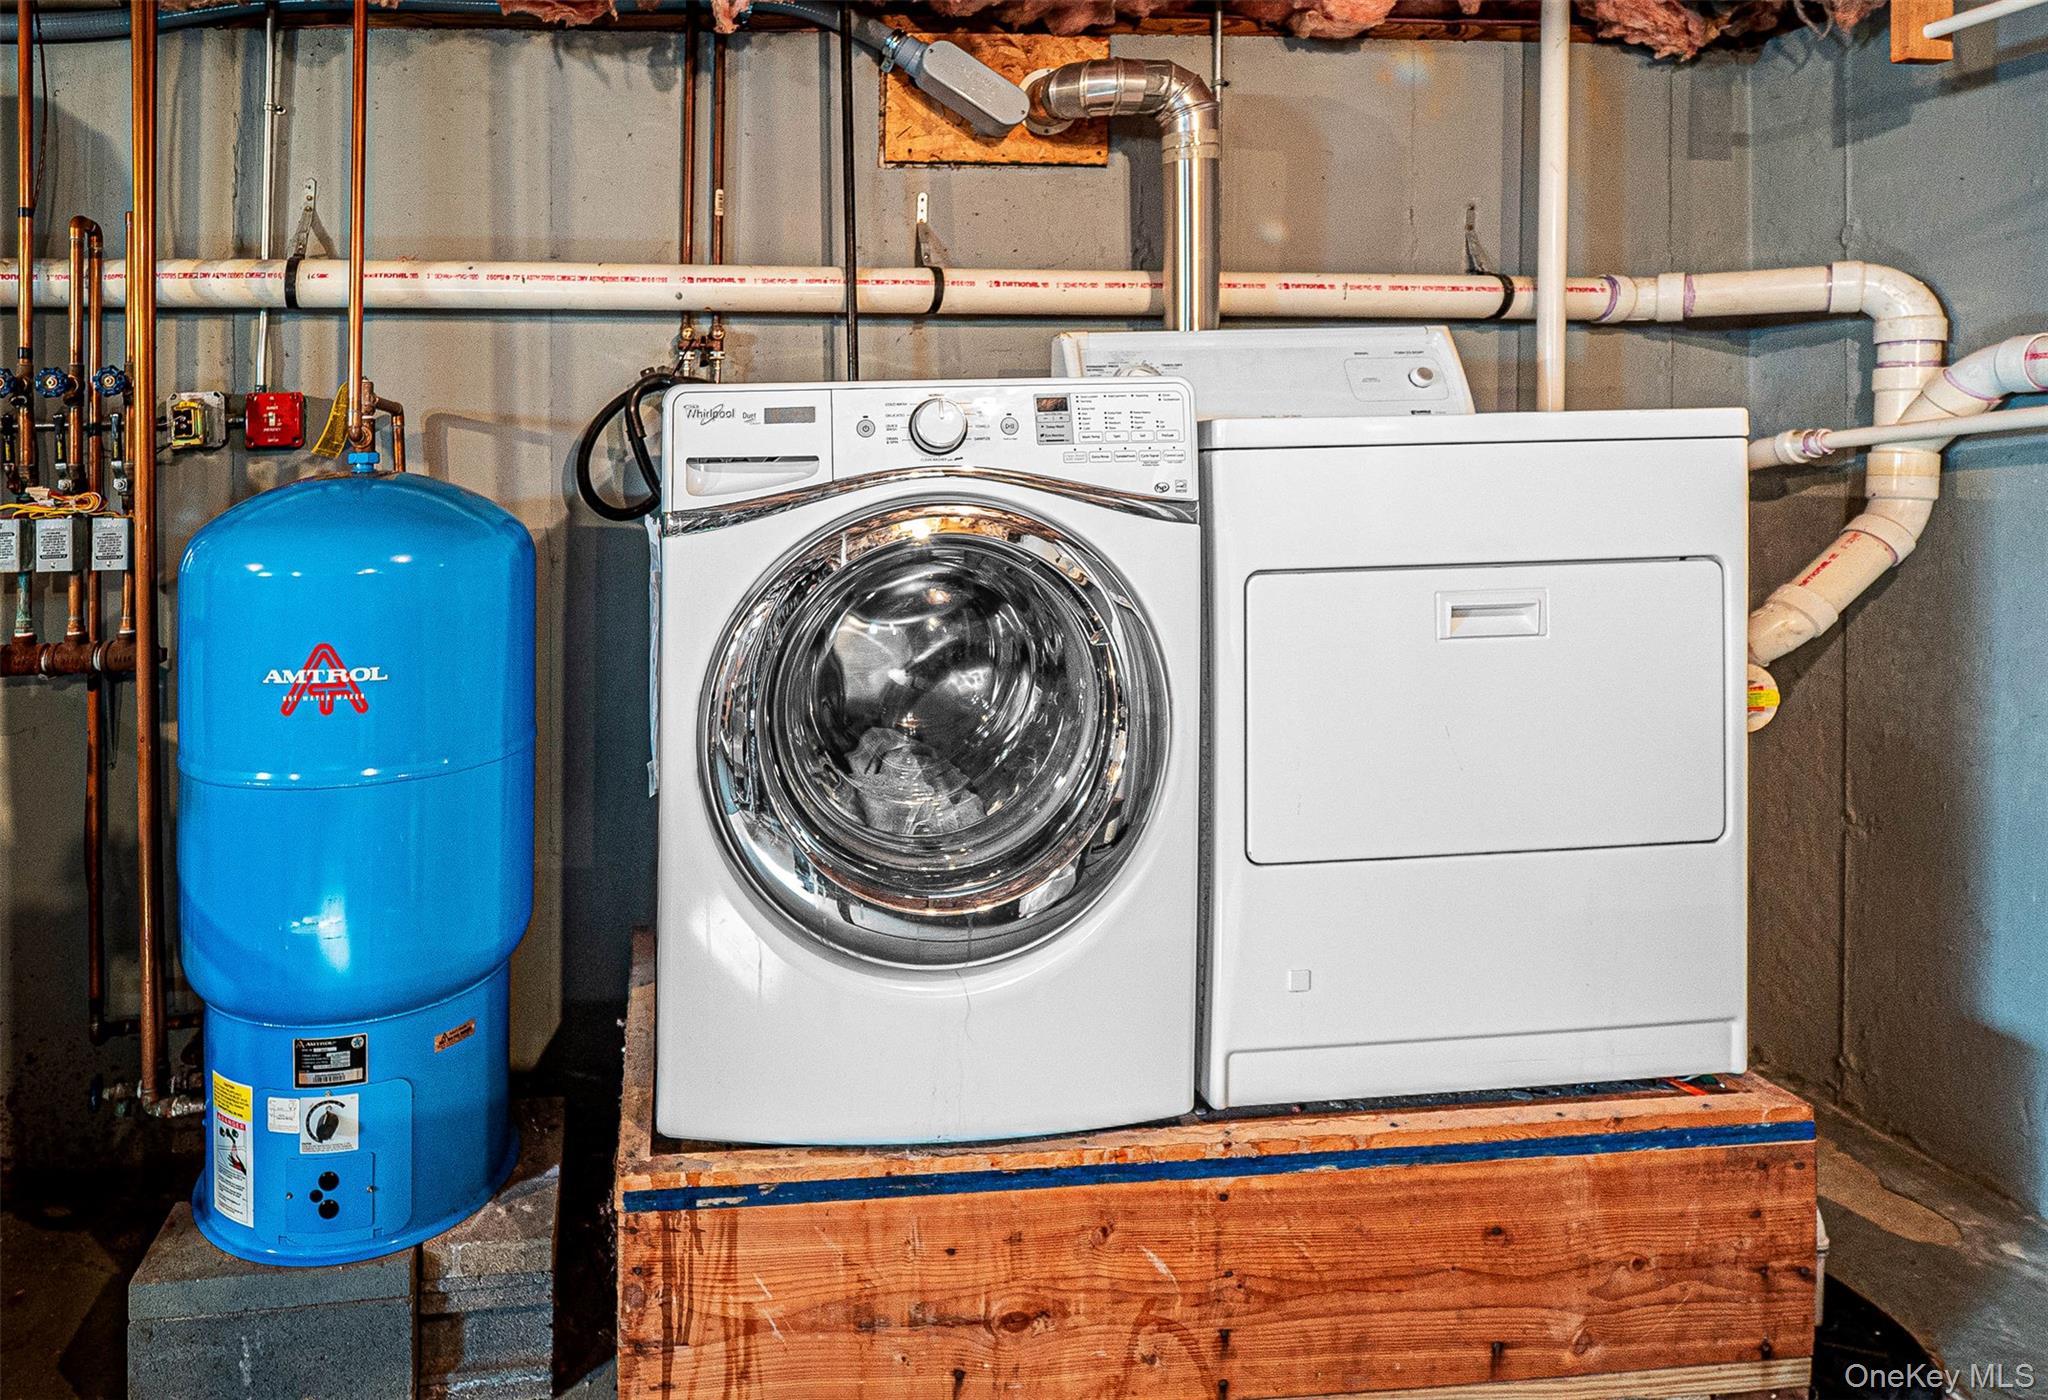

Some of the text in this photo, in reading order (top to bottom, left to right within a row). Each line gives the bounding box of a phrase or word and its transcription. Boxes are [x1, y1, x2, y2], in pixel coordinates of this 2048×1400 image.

[685, 405, 735, 421] Whirlpool
[262, 666, 389, 684] AMTROL
[302, 694, 330, 702] WATER
[335, 692, 365, 701] MAKER
